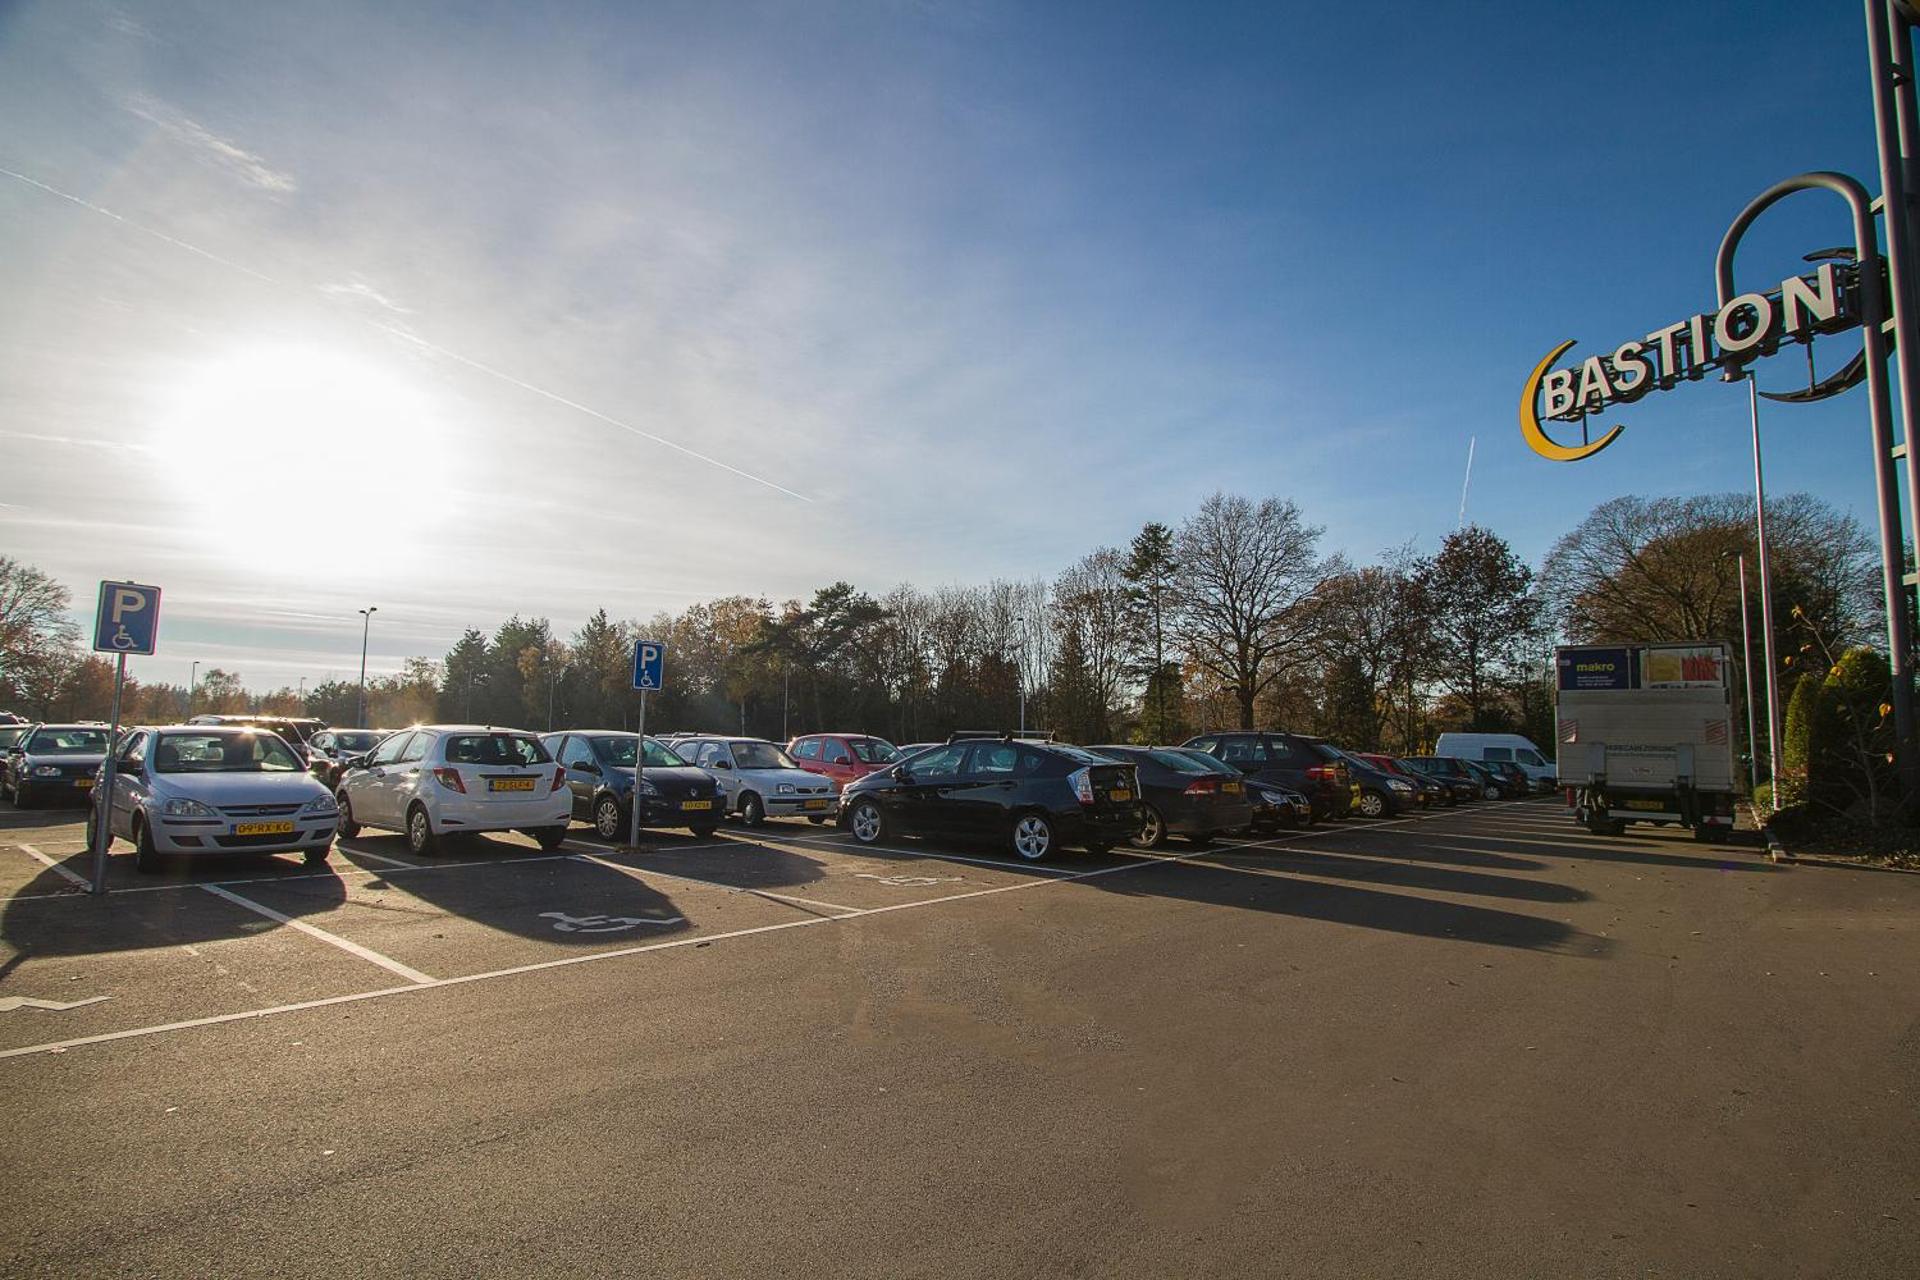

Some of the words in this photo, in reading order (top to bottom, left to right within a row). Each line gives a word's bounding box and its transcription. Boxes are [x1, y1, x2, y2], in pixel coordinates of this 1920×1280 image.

[1543, 263, 1836, 421] BASTION
[112, 589, 146, 623] P
[641, 645, 657, 669] P
[1576, 662, 1615, 672] makro
